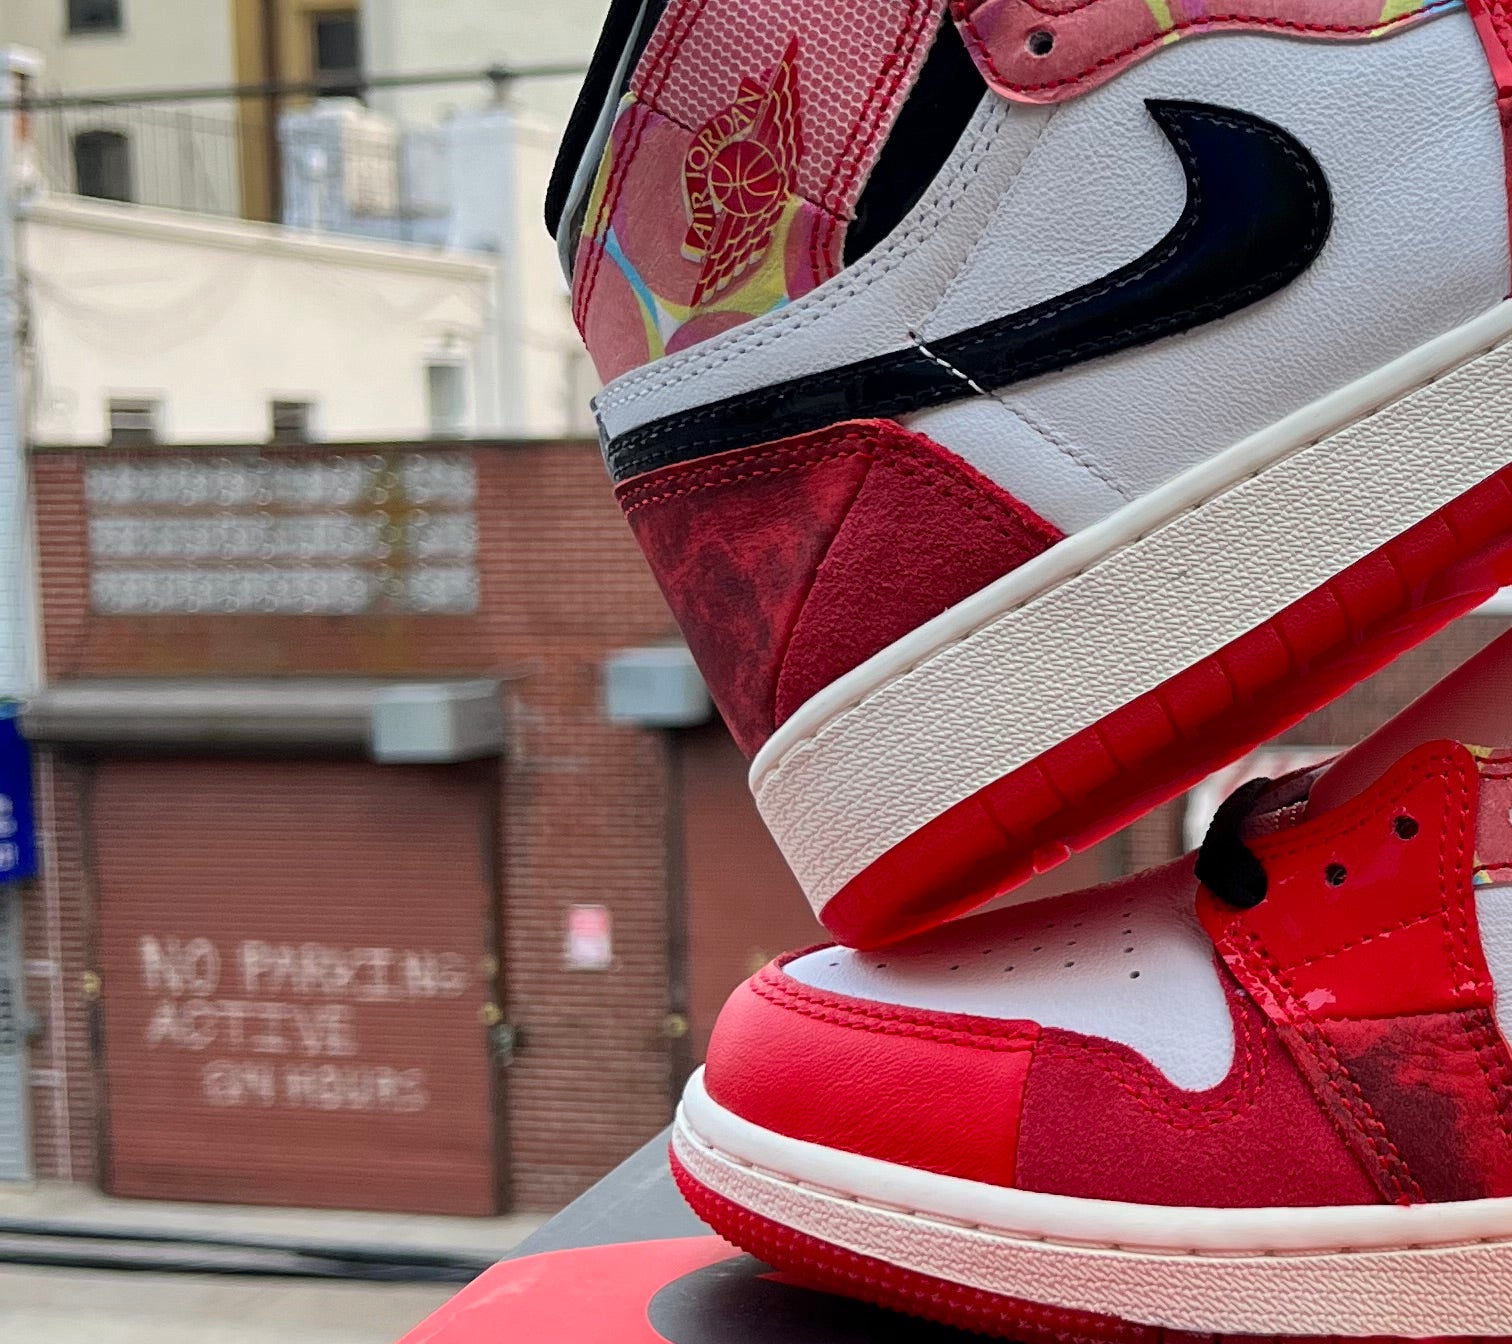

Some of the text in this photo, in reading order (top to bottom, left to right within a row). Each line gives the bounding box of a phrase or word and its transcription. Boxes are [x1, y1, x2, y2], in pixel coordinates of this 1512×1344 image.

[687, 86, 761, 243] AIR JORDAN
[138, 935, 221, 997] NO
[146, 999, 358, 1057] ACTIVE
[284, 1065, 430, 1112] HOURS
